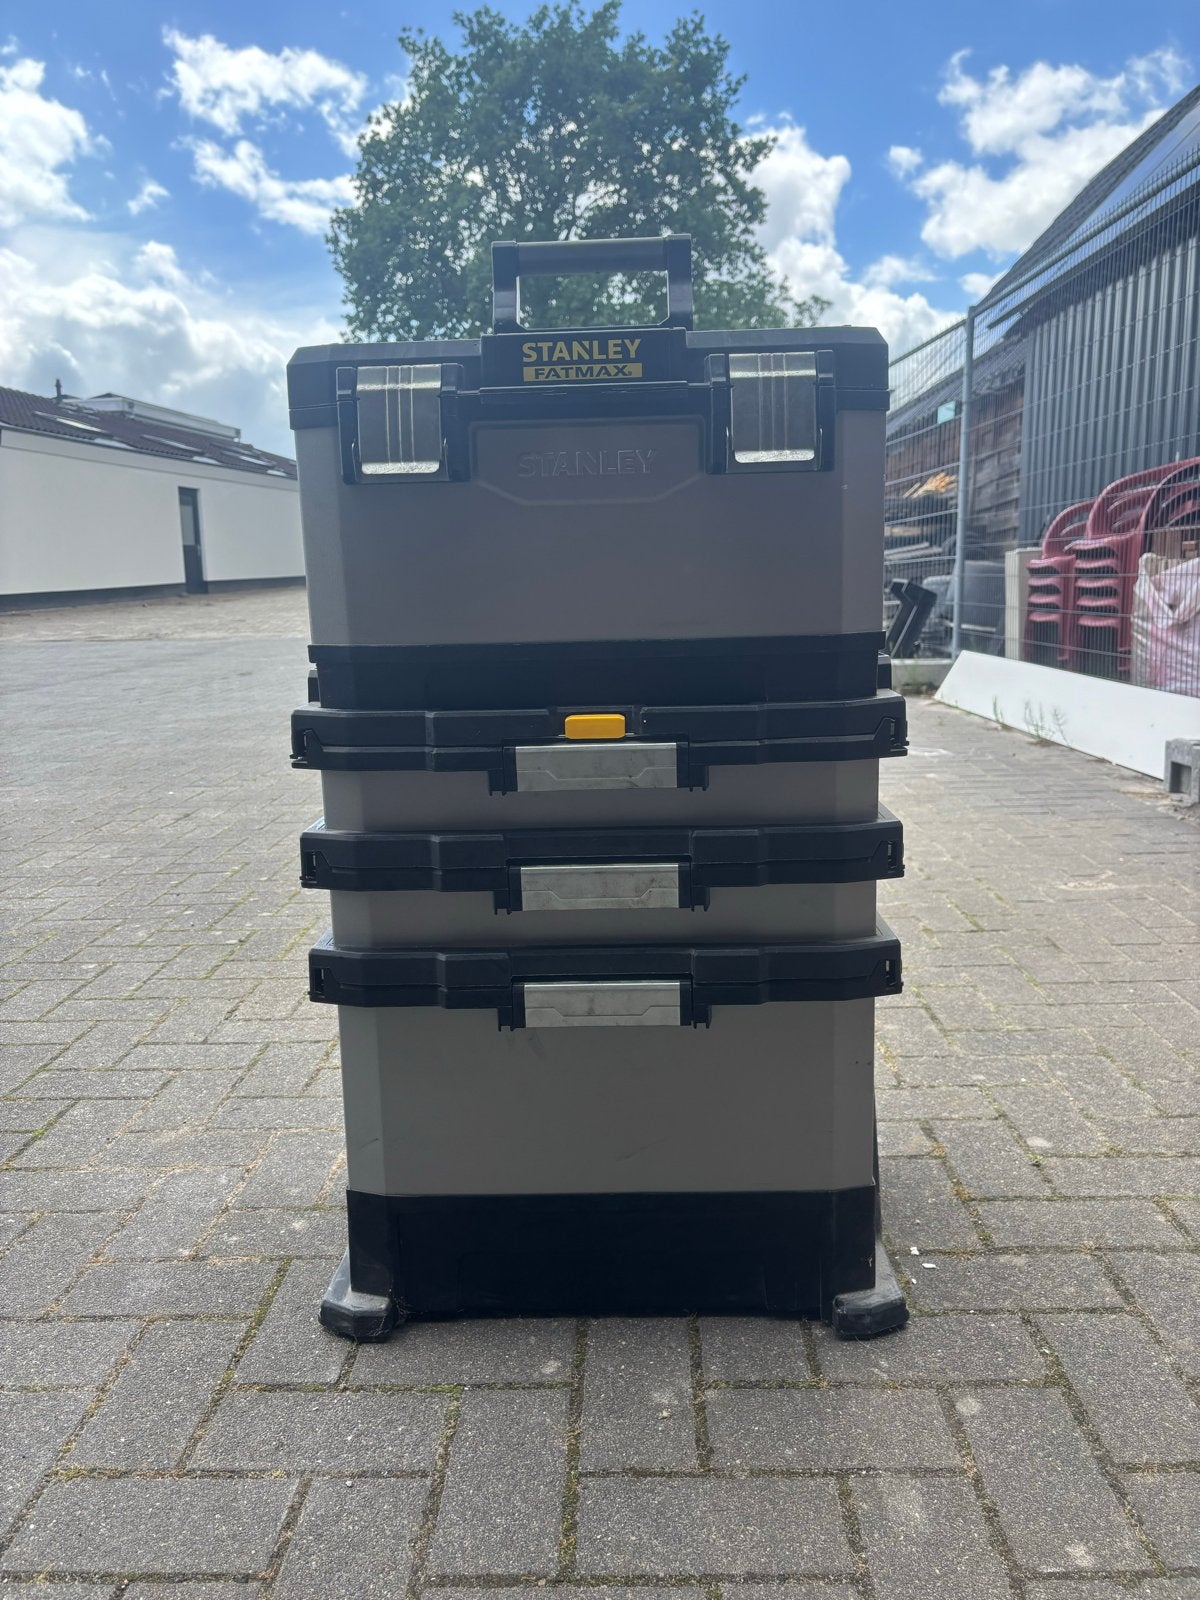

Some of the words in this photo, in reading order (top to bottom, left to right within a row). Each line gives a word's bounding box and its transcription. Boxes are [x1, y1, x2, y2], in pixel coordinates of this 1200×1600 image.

[522, 338, 641, 362] STANLEY
[534, 364, 630, 379] FATMAX
[518, 449, 654, 477] STANLEY
